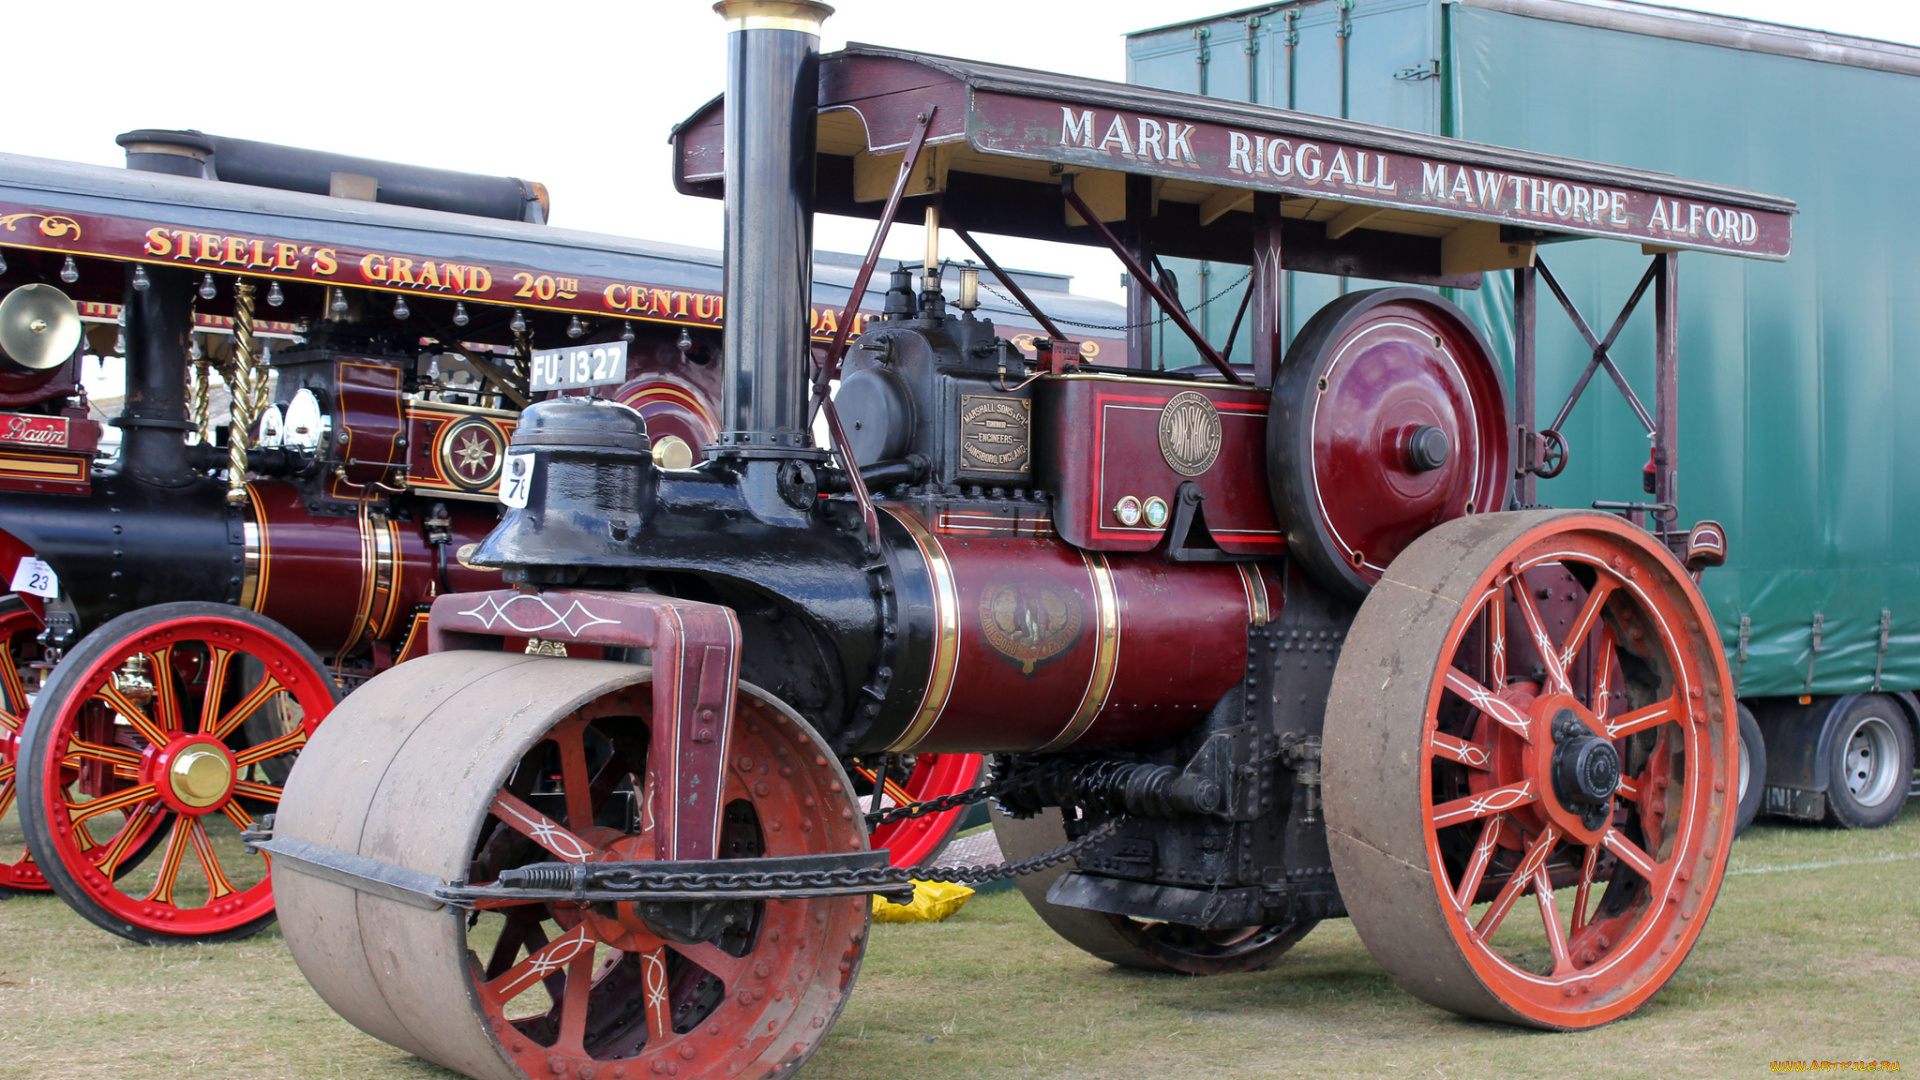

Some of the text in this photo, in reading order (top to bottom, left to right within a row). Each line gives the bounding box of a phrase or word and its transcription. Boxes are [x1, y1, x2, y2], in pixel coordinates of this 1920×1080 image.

[1060, 106, 1760, 247] MARK RIGGALL MAWTHORPE ALFORD
[144, 227, 339, 277] STEELE'S
[360, 253, 493, 295] GRAND
[603, 283, 723, 323] CENTU
[532, 347, 622, 386] FU 1327
[963, 403, 995, 425] MARSHALL
[996, 403, 1014, 416] SONS
[2, 416, 65, 444] Dawn
[978, 432, 1013, 444] ENGINEERS
[28, 573, 49, 591] 23
